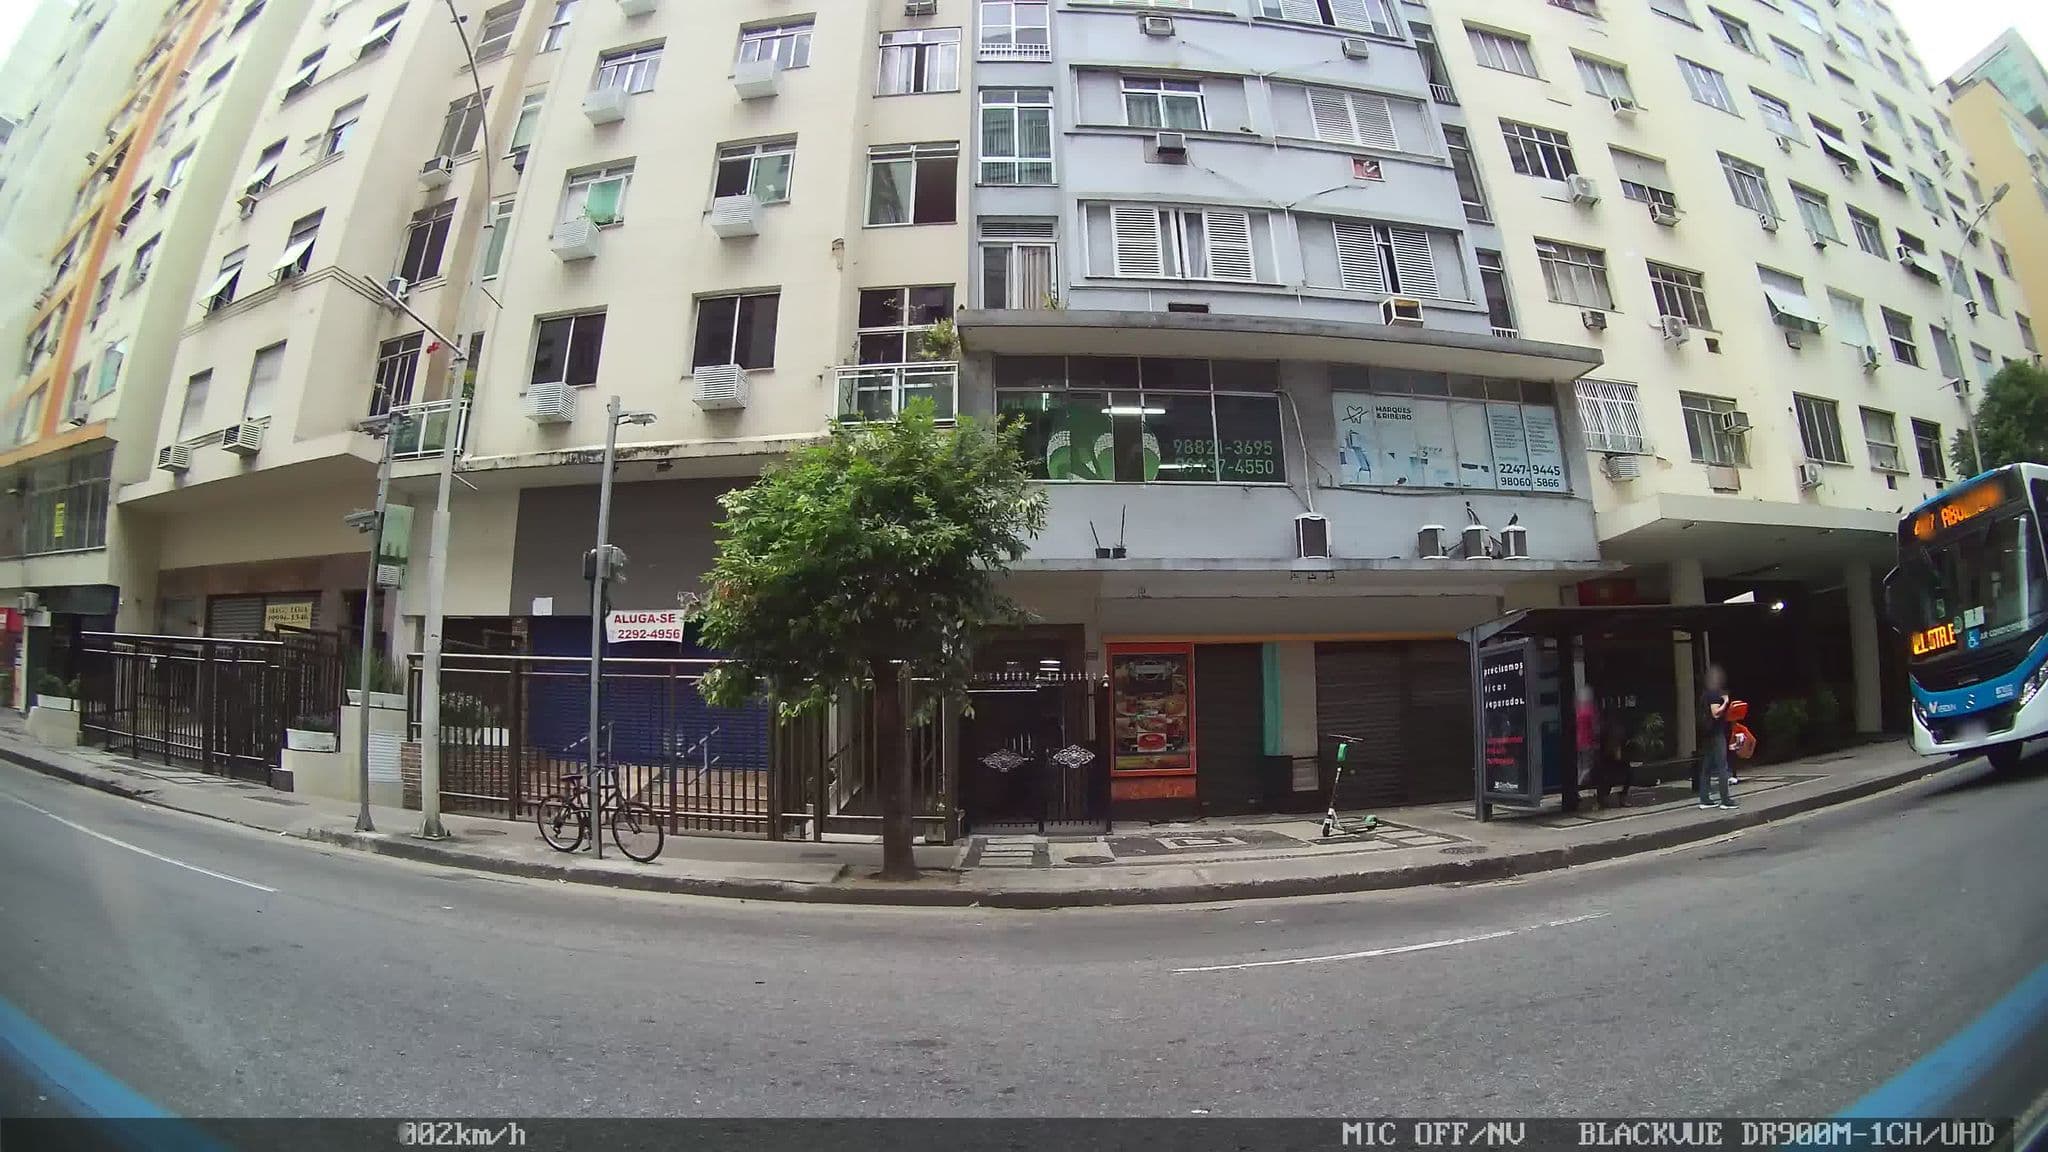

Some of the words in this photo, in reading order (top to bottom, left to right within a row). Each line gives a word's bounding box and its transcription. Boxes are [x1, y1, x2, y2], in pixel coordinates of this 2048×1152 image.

[1376, 406, 1411, 414] MARQUES
[1173, 439, 1273, 456] 98821-3695
[1499, 463, 1560, 476] 2247-9445
[1501, 477, 1559, 487] 98060-5866
[614, 614, 676, 624] ALUGA-SE
[618, 629, 680, 639] 2292-4956
